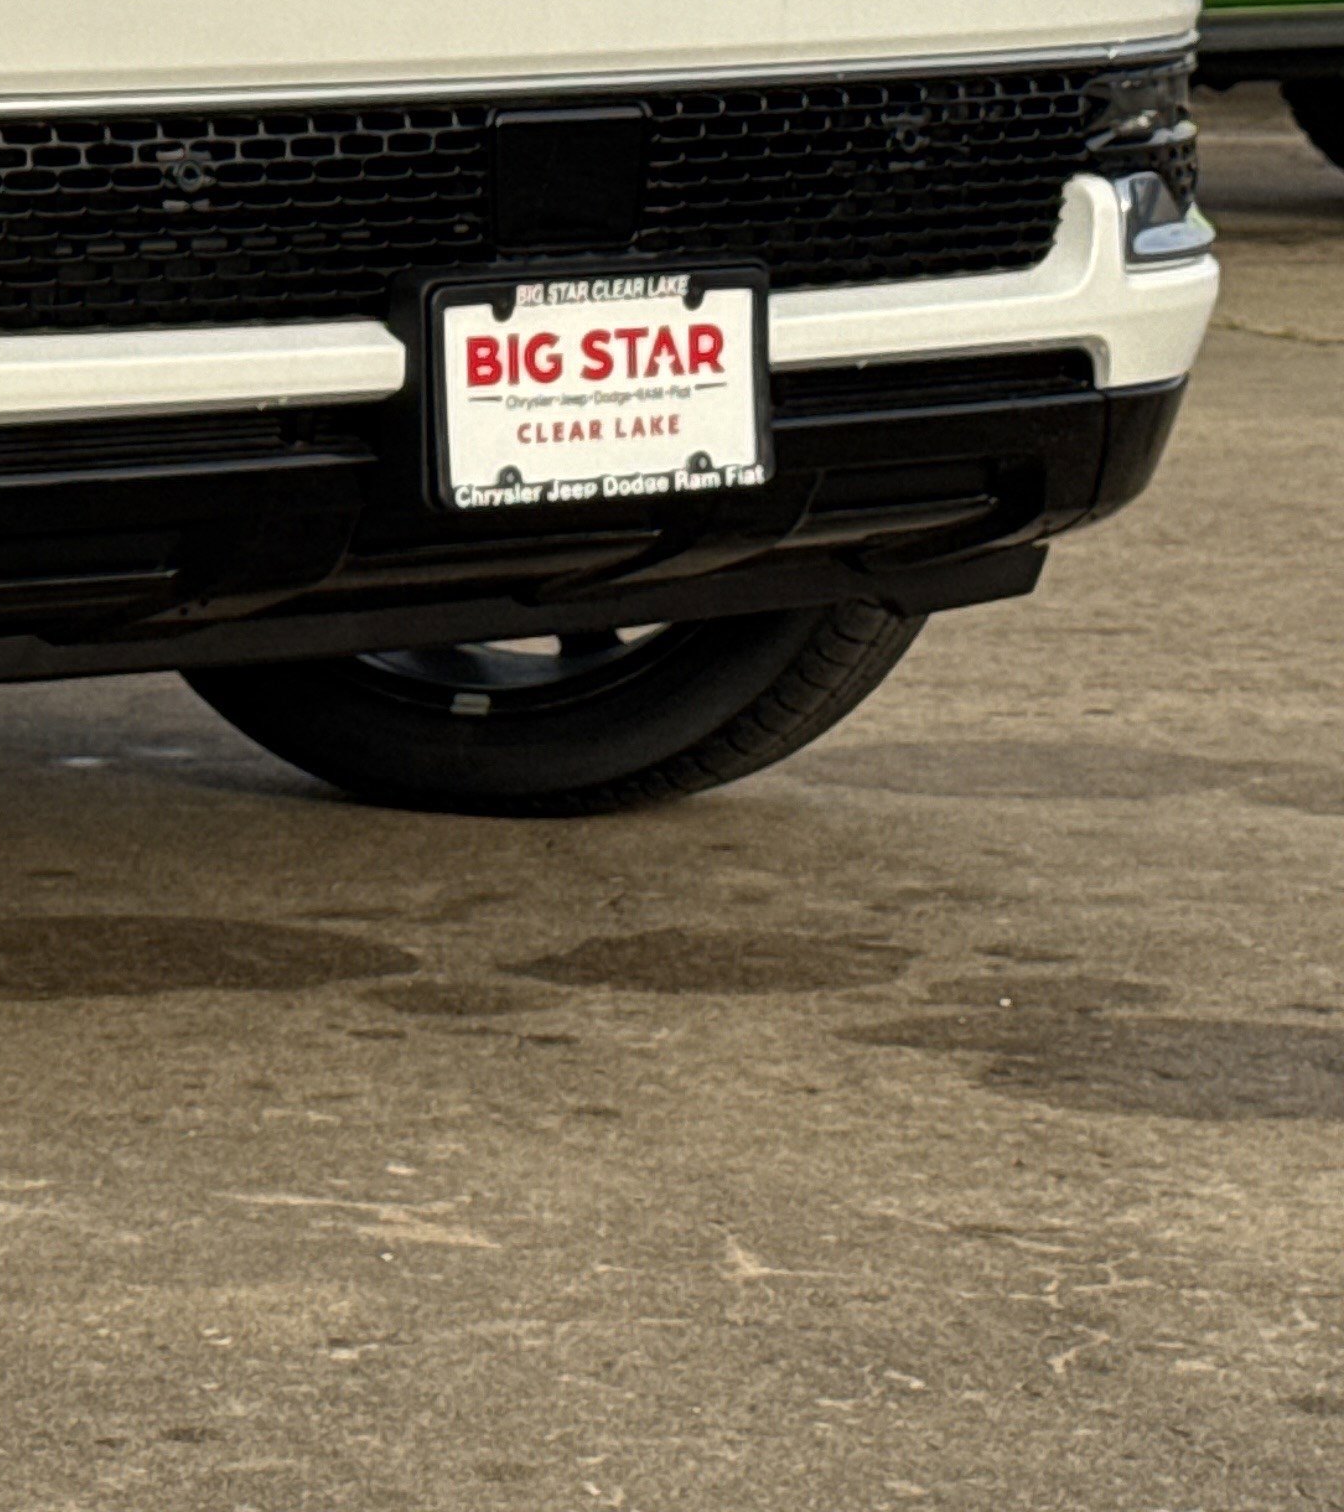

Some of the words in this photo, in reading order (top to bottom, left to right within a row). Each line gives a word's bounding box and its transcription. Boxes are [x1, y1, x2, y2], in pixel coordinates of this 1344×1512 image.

[515, 282, 545, 307] BIG
[546, 280, 589, 305] STAR
[591, 276, 646, 302] CLEAR
[648, 273, 691, 298] LAKE
[465, 331, 564, 387] BIG
[579, 323, 726, 381] STAR
[517, 418, 603, 444] CLEAR
[614, 414, 680, 439] LAKE
[454, 482, 543, 509] Chrysler
[547, 478, 599, 502] Jeep
[603, 474, 670, 498] Dodge
[674, 469, 722, 492] Ram
[725, 464, 765, 486] Fiat
